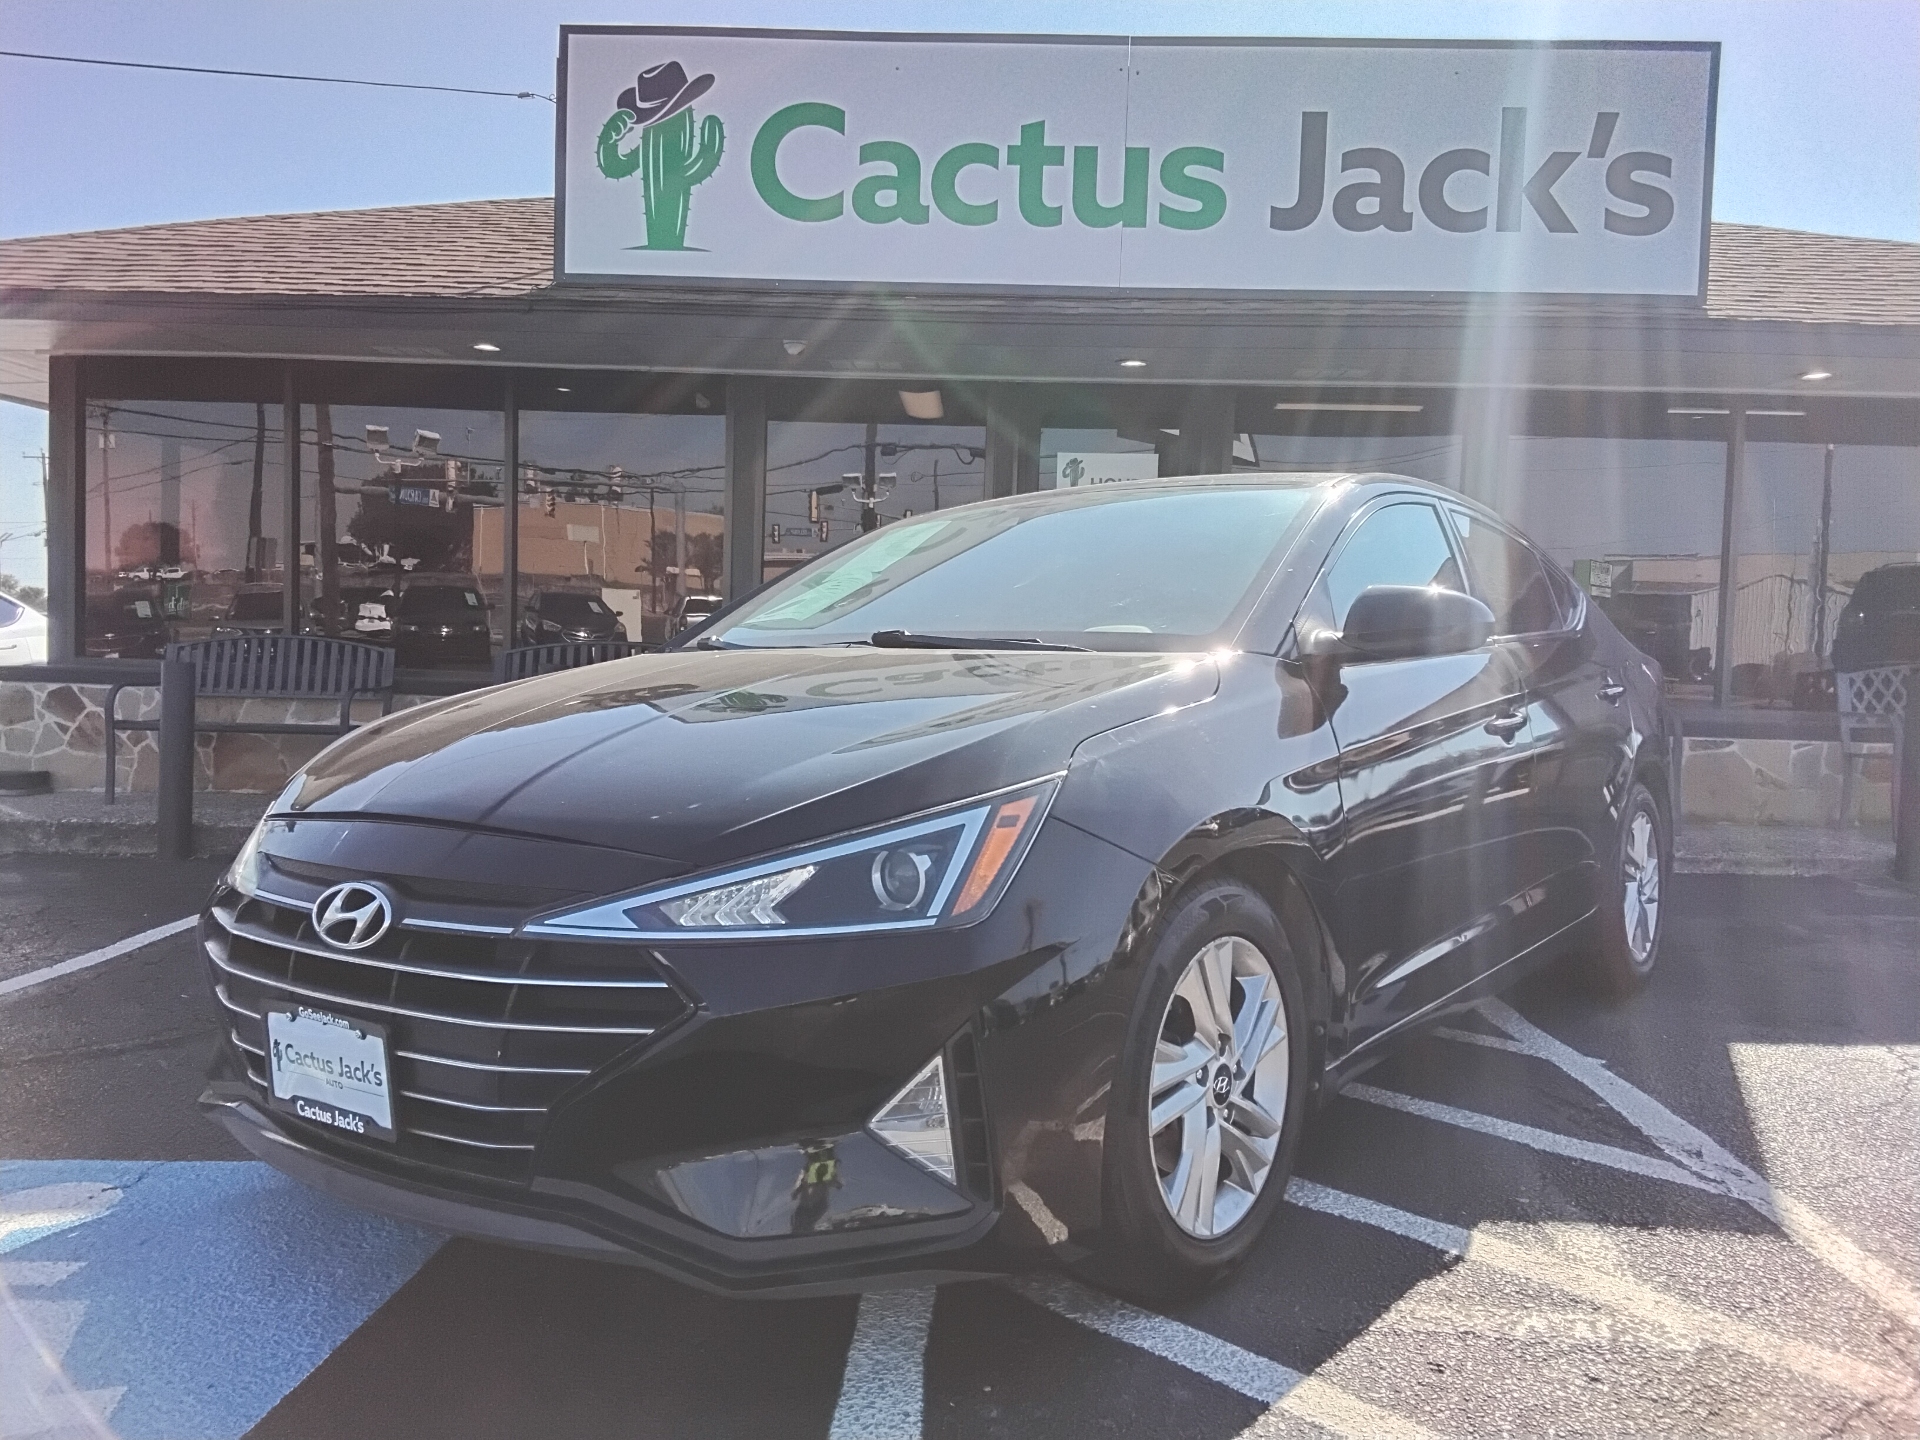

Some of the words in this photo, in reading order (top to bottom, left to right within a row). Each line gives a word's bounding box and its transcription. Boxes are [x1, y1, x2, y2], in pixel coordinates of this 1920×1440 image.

[750, 101, 1228, 231] Cactus
[1269, 106, 1675, 237] Jack's
[284, 1043, 334, 1075] Cactus
[338, 1056, 383, 1087] Jack's
[325, 1078, 344, 1090] AUTO
[297, 1100, 332, 1124] Cactus
[334, 1110, 365, 1134] Jack's
